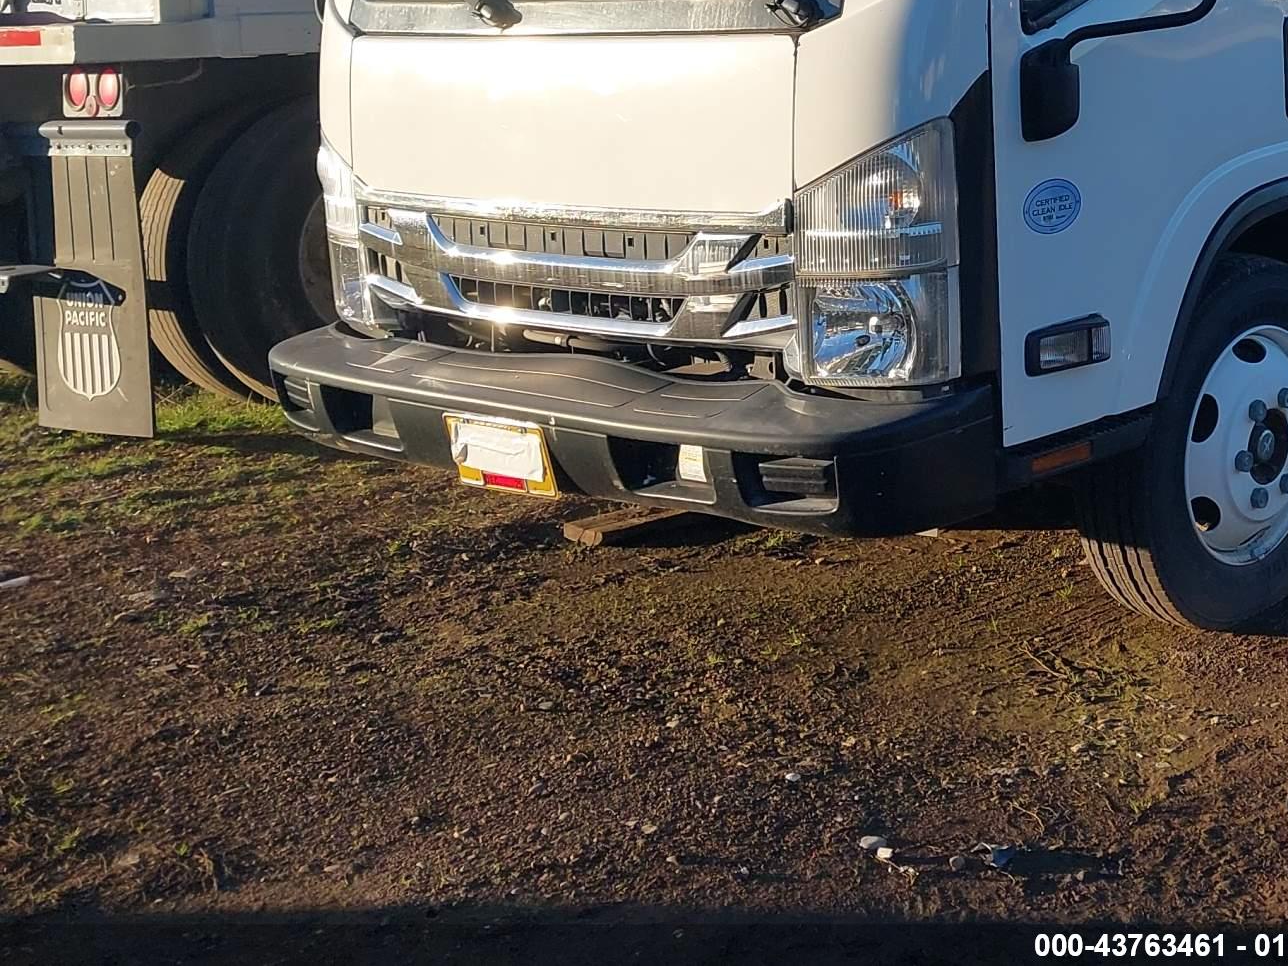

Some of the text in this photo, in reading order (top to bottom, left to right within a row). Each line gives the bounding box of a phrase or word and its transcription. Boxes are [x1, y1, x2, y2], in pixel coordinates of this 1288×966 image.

[1035, 194, 1070, 207] CERTIFIED
[1032, 202, 1073, 217] CLEAN IDLE
[66, 291, 104, 308] UNION
[65, 310, 107, 327] PACIFIC
